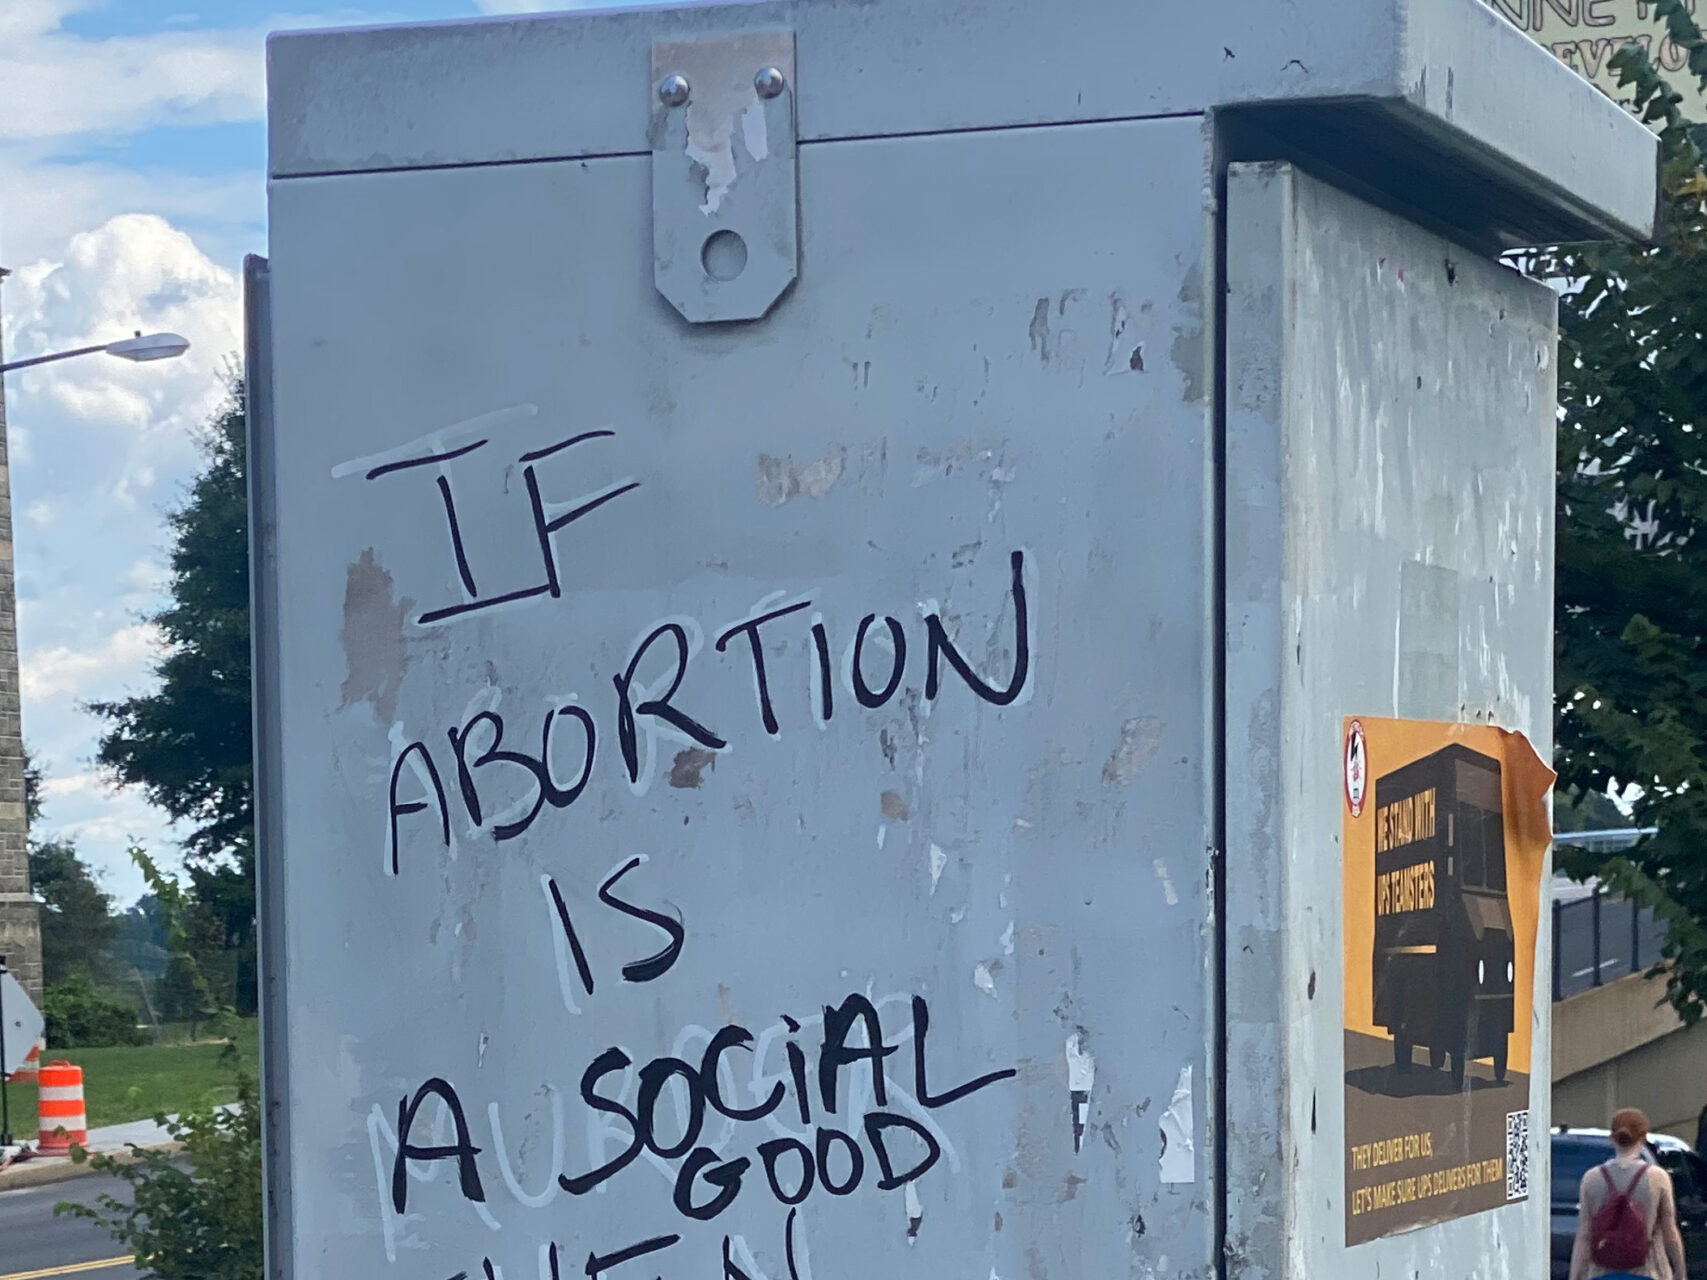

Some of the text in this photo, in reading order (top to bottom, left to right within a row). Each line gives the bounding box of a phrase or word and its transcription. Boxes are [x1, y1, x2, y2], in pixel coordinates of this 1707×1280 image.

[366, 429, 641, 624] IF
[388, 550, 1030, 877] ABORTION
[1389, 796, 1413, 850] STAND
[1414, 787, 1436, 842] WITH
[546, 856, 686, 996] IS
[1391, 860, 1436, 915] TEAMSTERS
[391, 1076, 487, 1215] A
[672, 1110, 942, 1221] GOOD
[1351, 1145, 1371, 1171] THEY
[1373, 1138, 1403, 1167] DELIVER
[1404, 1134, 1420, 1160] FOR
[1352, 1187, 1372, 1215] LET'S
[1373, 1180, 1396, 1210] MAKE
[1397, 1176, 1416, 1204] SURE
[1417, 1173, 1432, 1200] UPS
[1433, 1167, 1466, 1194] DELIVERS
[1467, 1161, 1482, 1188] FOR
